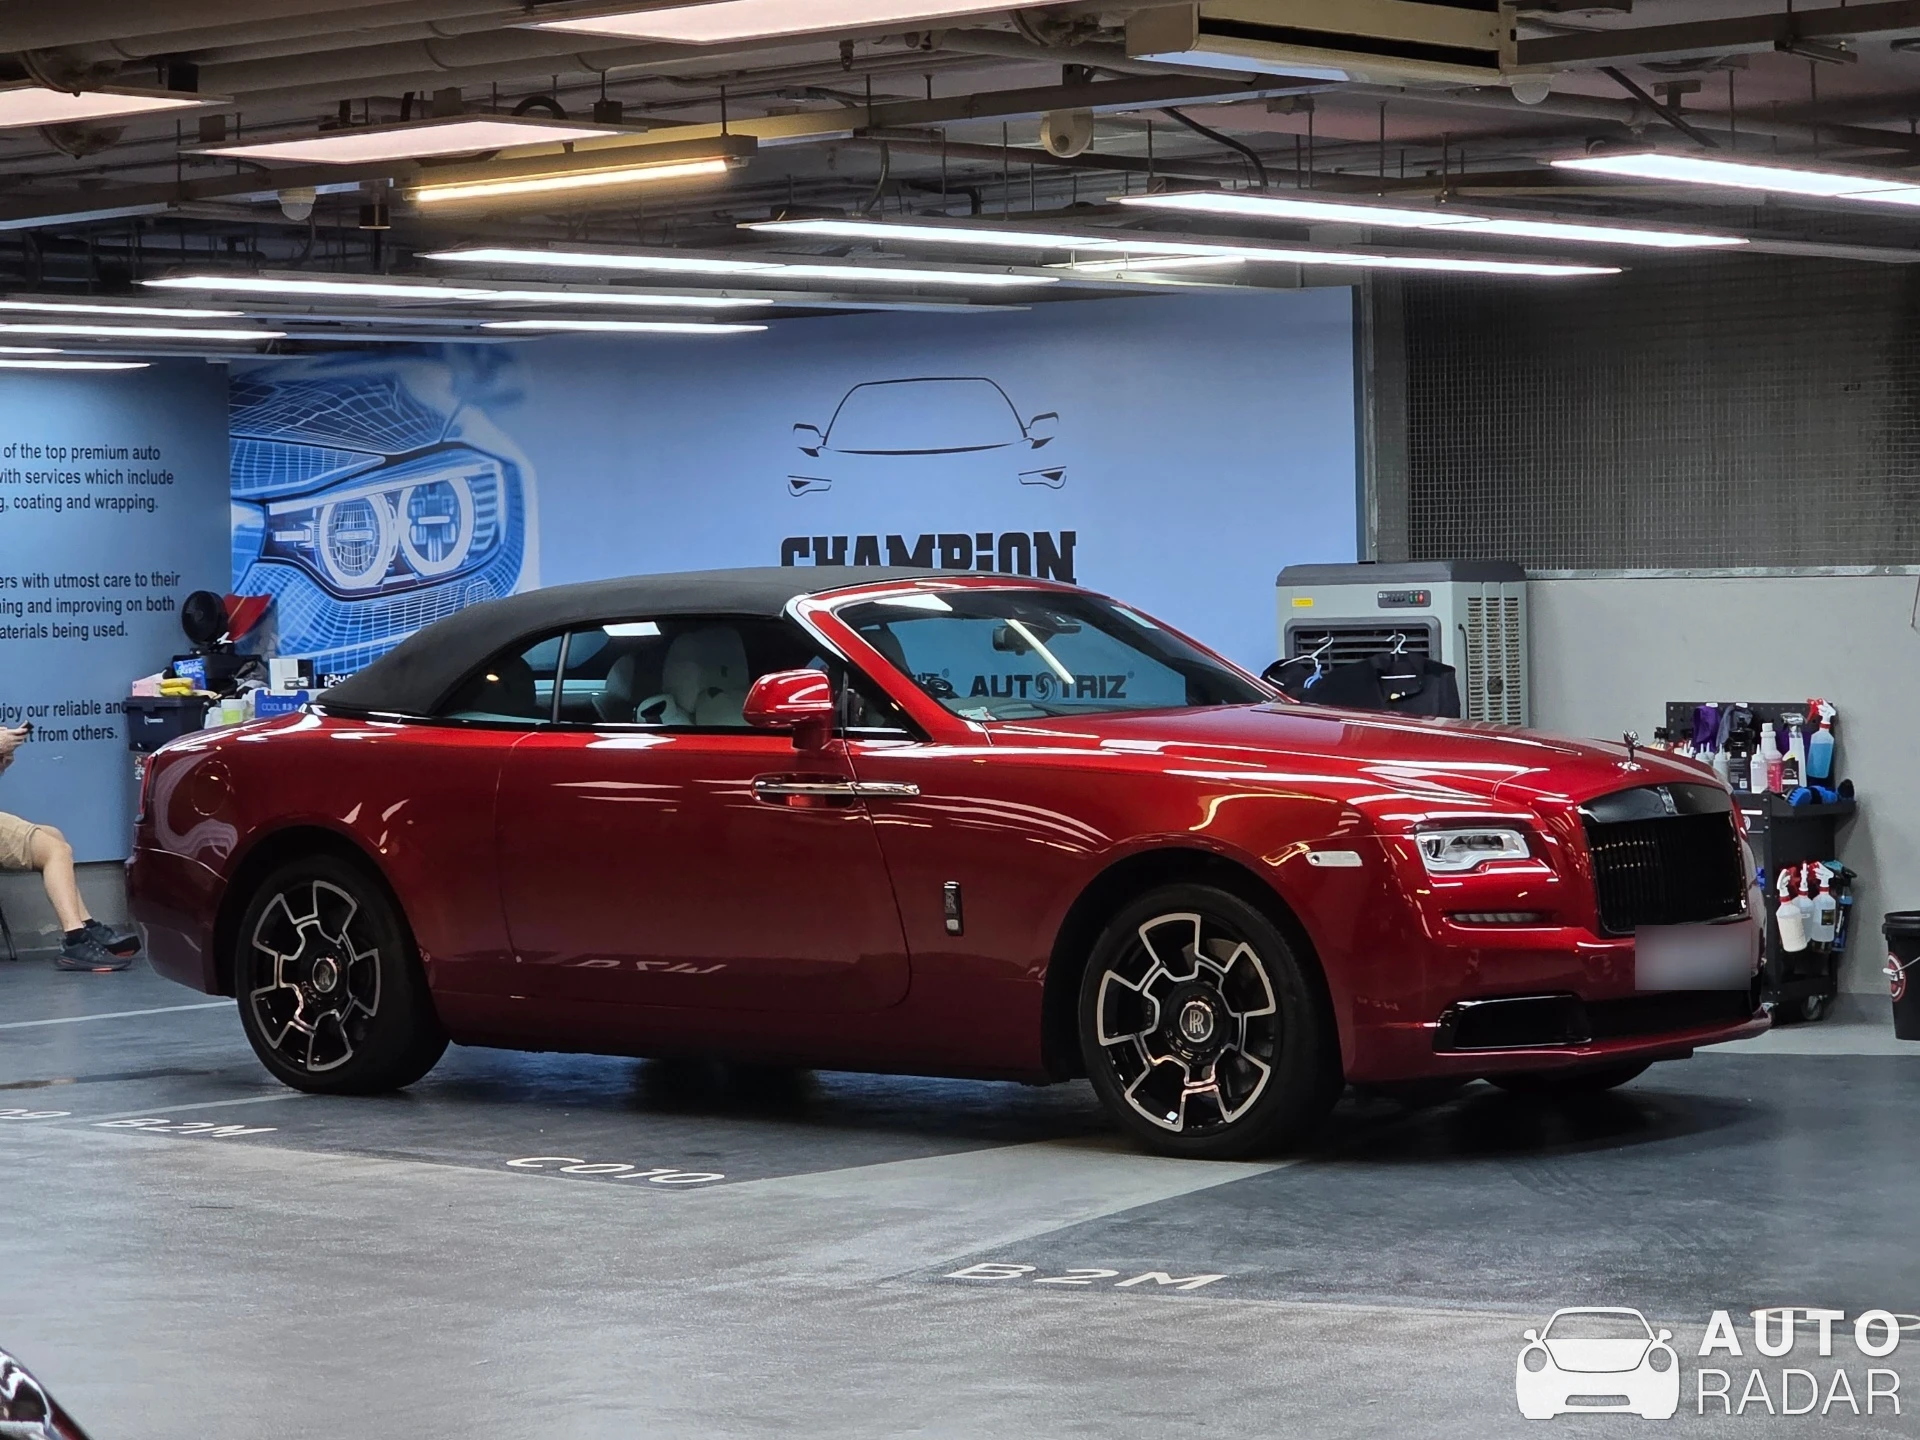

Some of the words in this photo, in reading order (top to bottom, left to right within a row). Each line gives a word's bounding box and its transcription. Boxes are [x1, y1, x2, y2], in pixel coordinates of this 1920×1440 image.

[4, 443, 17, 459] of
[21, 443, 42, 459] the
[45, 444, 67, 463] top
[71, 444, 129, 463] premium
[132, 445, 161, 461] auto
[25, 469, 81, 485] services
[85, 469, 124, 485] which
[127, 469, 174, 485] include
[14, 494, 62, 513] coating
[66, 494, 91, 510] and
[94, 494, 159, 513] wrapping.
[22, 572, 50, 589] with
[54, 573, 100, 589] utmost
[103, 574, 131, 588] care
[135, 572, 148, 588] to
[151, 571, 181, 588] their
[0, 598, 23, 618] ing
[27, 597, 52, 614] and
[56, 596, 123, 617] improving
[126, 598, 143, 612] on
[146, 595, 175, 612] both
[0, 622, 49, 640] aterials
[52, 622, 89, 642] being
[93, 620, 129, 638] used.
[0, 702, 23, 723] joy
[27, 705, 50, 718] our
[53, 699, 101, 717] reliable
[38, 726, 69, 742] from
[72, 724, 118, 740] others.
[90, 1118, 279, 1138] B2M
[943, 1262, 1228, 1290] B2M
